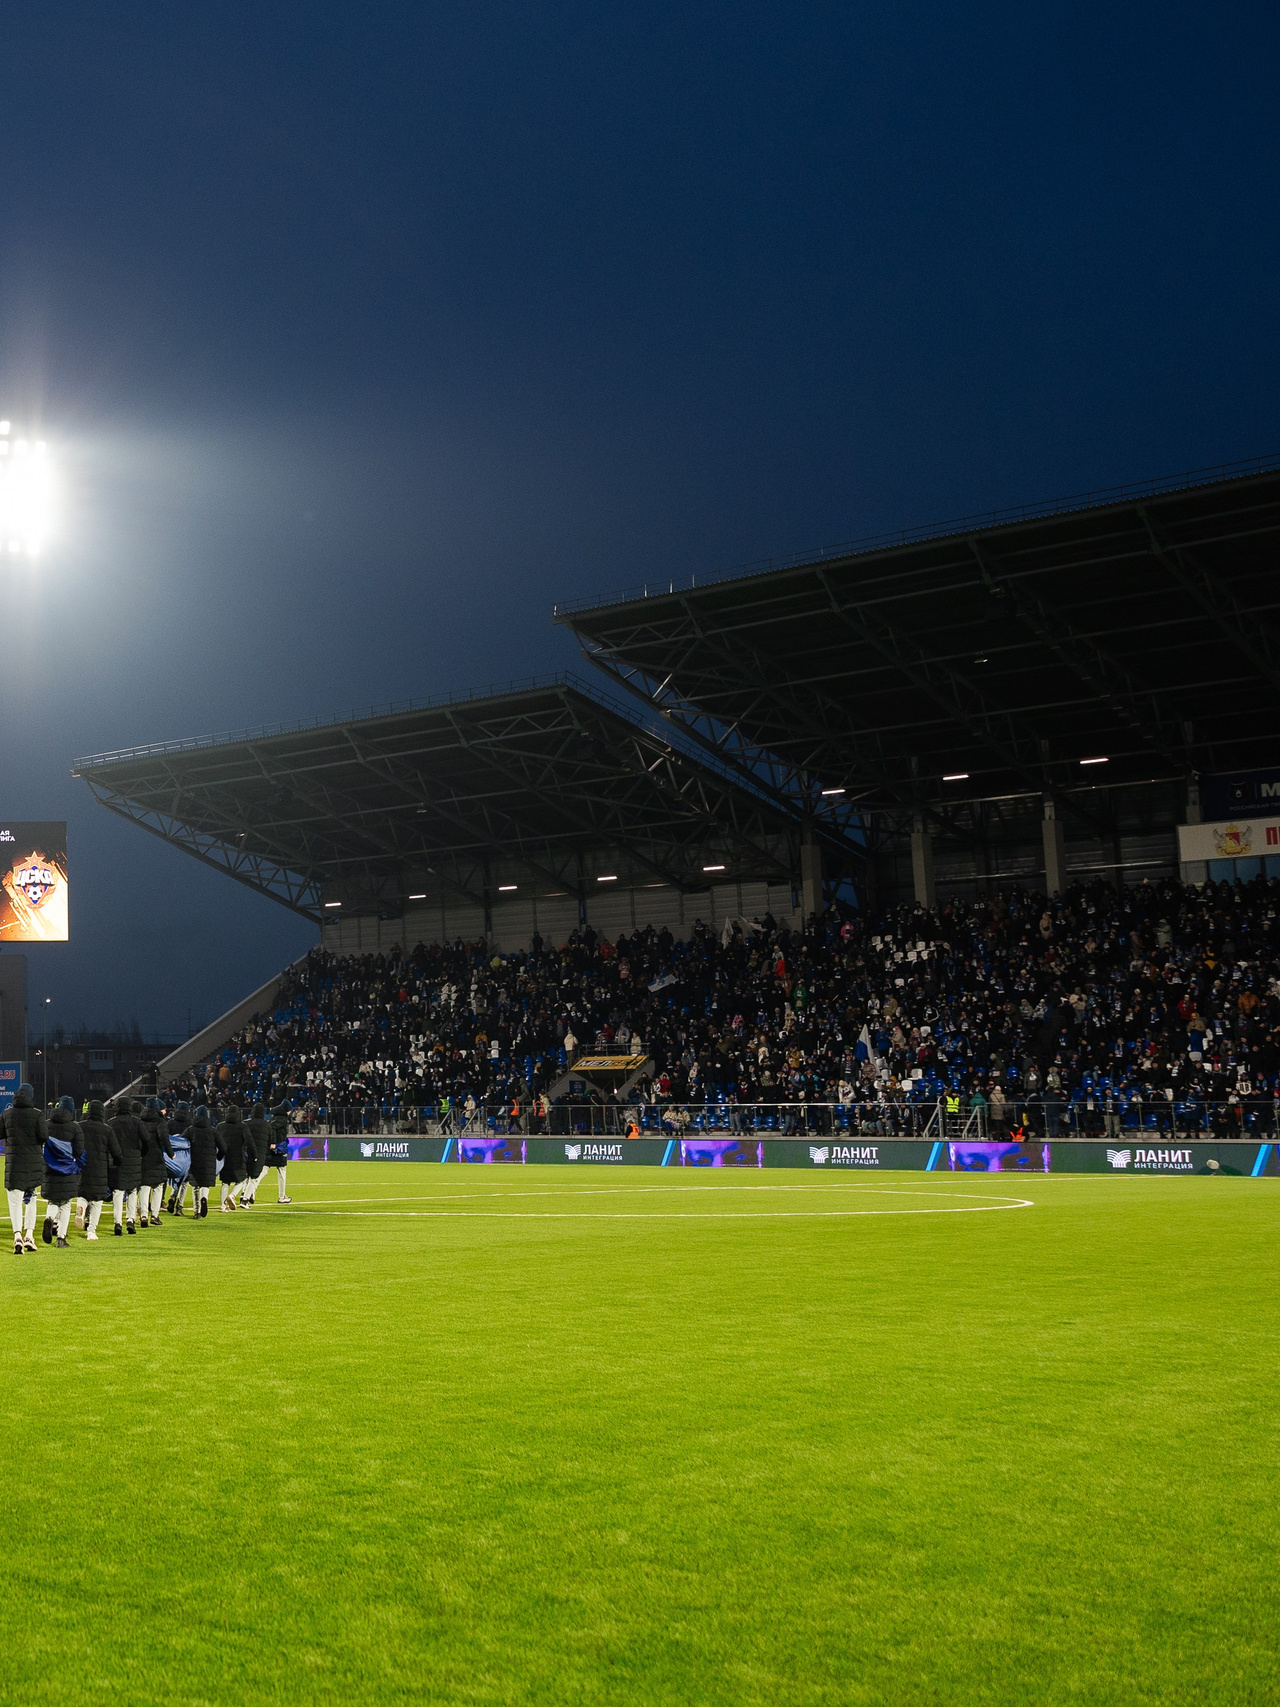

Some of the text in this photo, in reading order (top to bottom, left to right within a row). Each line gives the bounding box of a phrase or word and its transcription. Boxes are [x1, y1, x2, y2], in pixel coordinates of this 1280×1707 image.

[1265, 826, 1280, 846] П
[15, 869, 55, 887] ЦСКА
[376, 1143, 409, 1152] ЛАНИТ
[583, 1144, 622, 1155] ЛАНИТ
[831, 1147, 878, 1158] ЛАНИТ
[1134, 1149, 1192, 1162] ЛАНИТ
